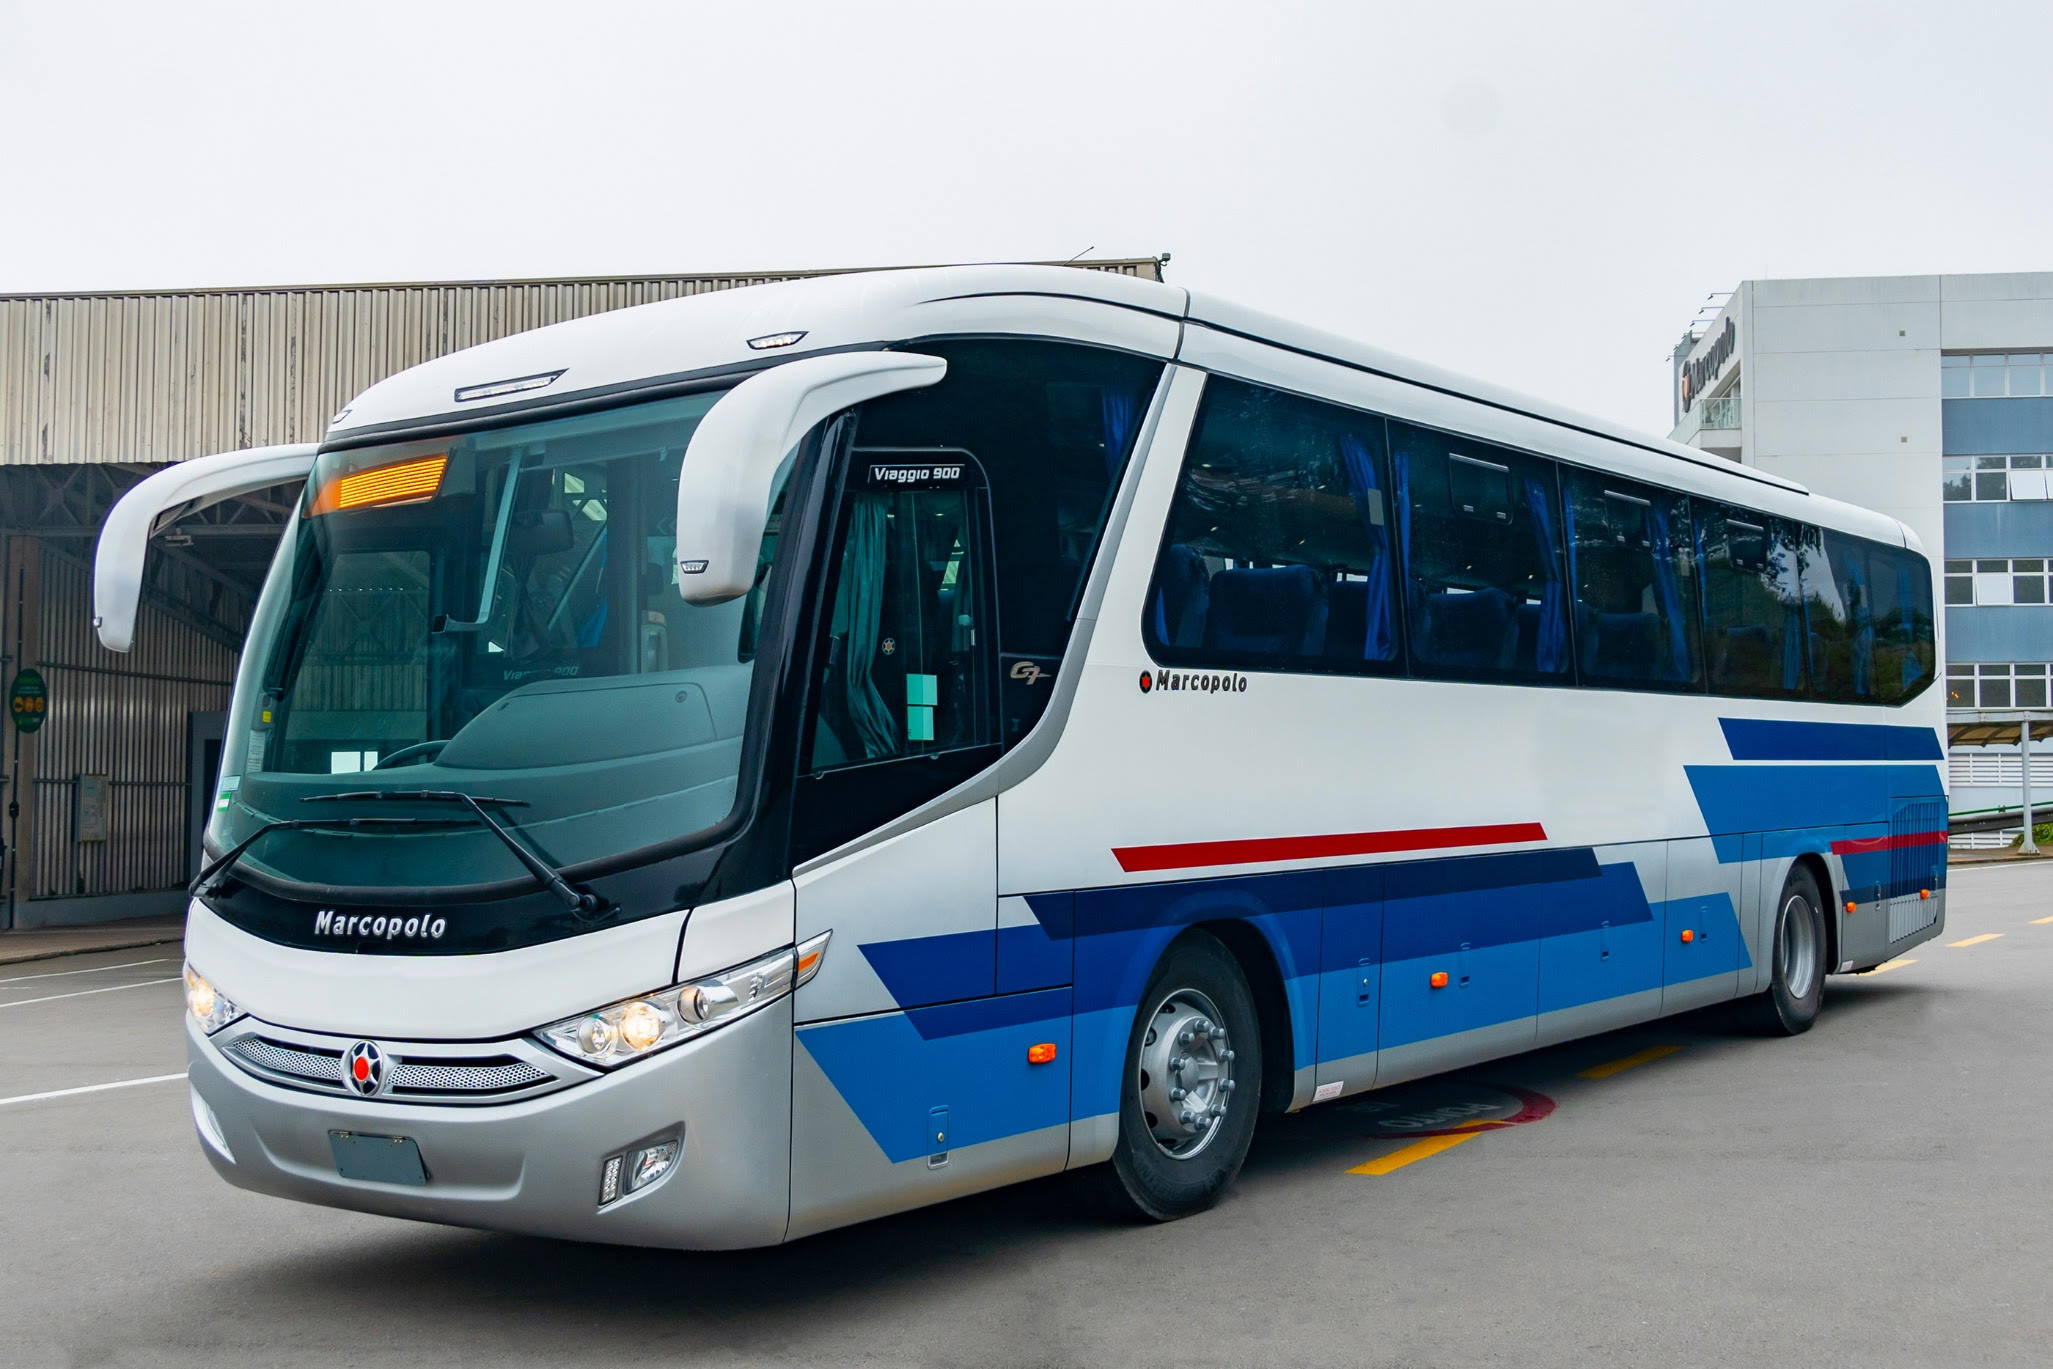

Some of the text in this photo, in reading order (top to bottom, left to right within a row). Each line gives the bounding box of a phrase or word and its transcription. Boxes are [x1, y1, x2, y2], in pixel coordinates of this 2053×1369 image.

[874, 467, 961, 483] Viaggio 900
[1155, 669, 1247, 694] Marcopolo
[314, 910, 446, 940] Marcopolo
